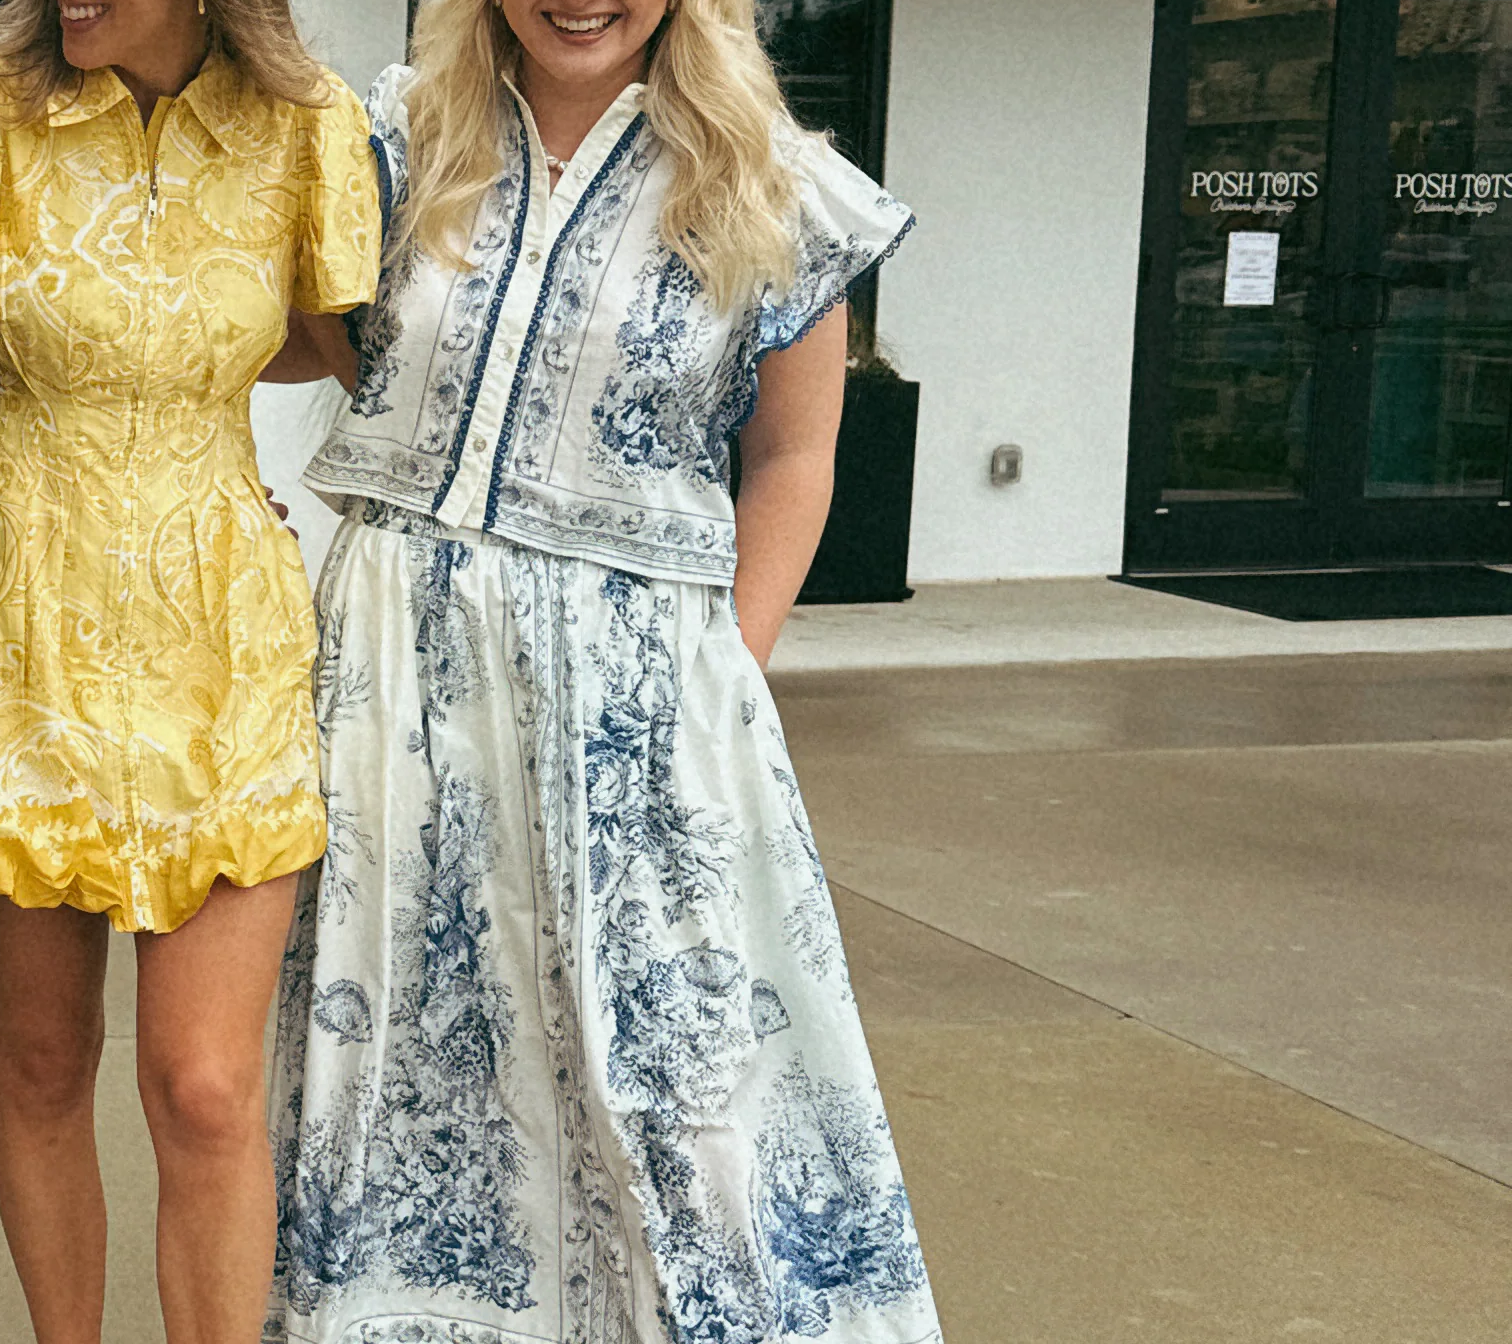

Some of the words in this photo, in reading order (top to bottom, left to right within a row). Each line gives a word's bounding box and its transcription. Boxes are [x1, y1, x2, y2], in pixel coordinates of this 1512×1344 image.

[1190, 171, 1254, 197] POSH
[1259, 171, 1319, 197] TOTS
[1394, 172, 1457, 198] POSH
